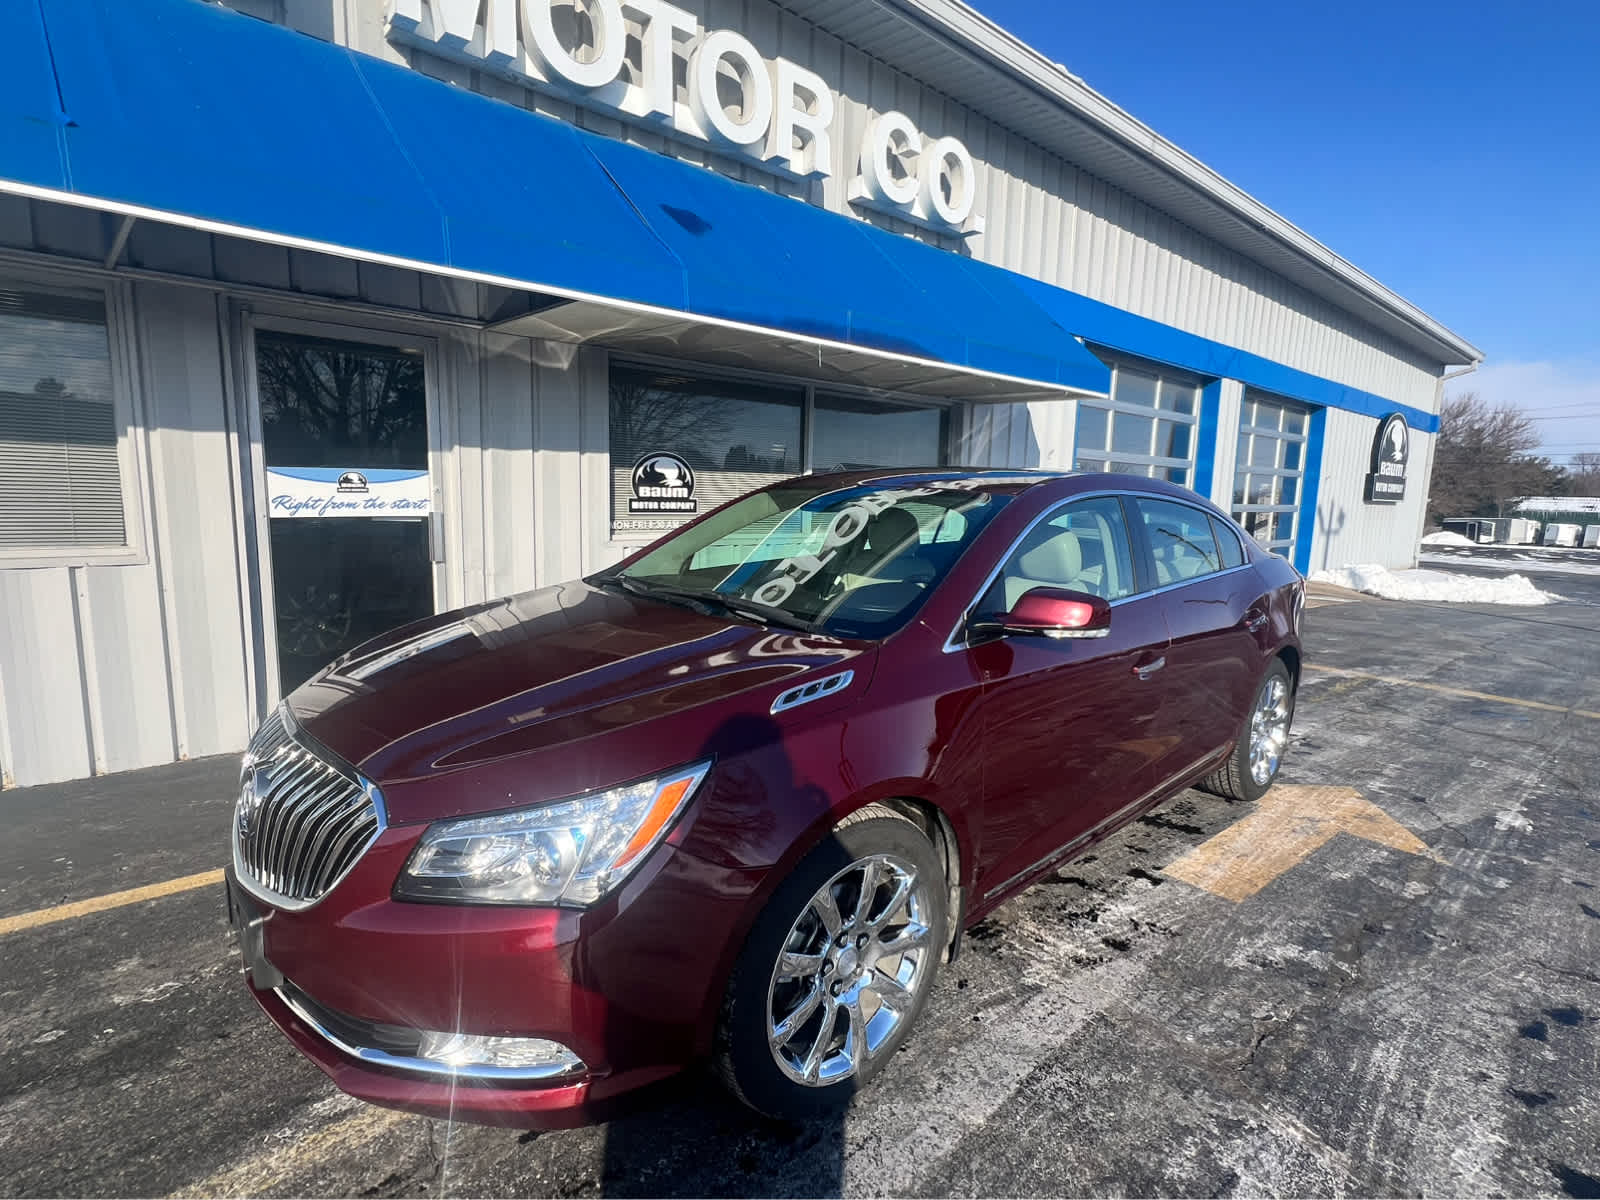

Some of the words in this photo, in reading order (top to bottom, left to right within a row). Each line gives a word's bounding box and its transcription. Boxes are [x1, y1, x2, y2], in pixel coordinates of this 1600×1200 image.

[385, 0, 834, 177] OTOR
[638, 486, 688, 498] Baum
[271, 494, 323, 516] Right
[318, 495, 360, 516] from
[361, 495, 388, 510] the
[631, 501, 659, 510] MOTOR
[660, 501, 695, 510] COMPANY
